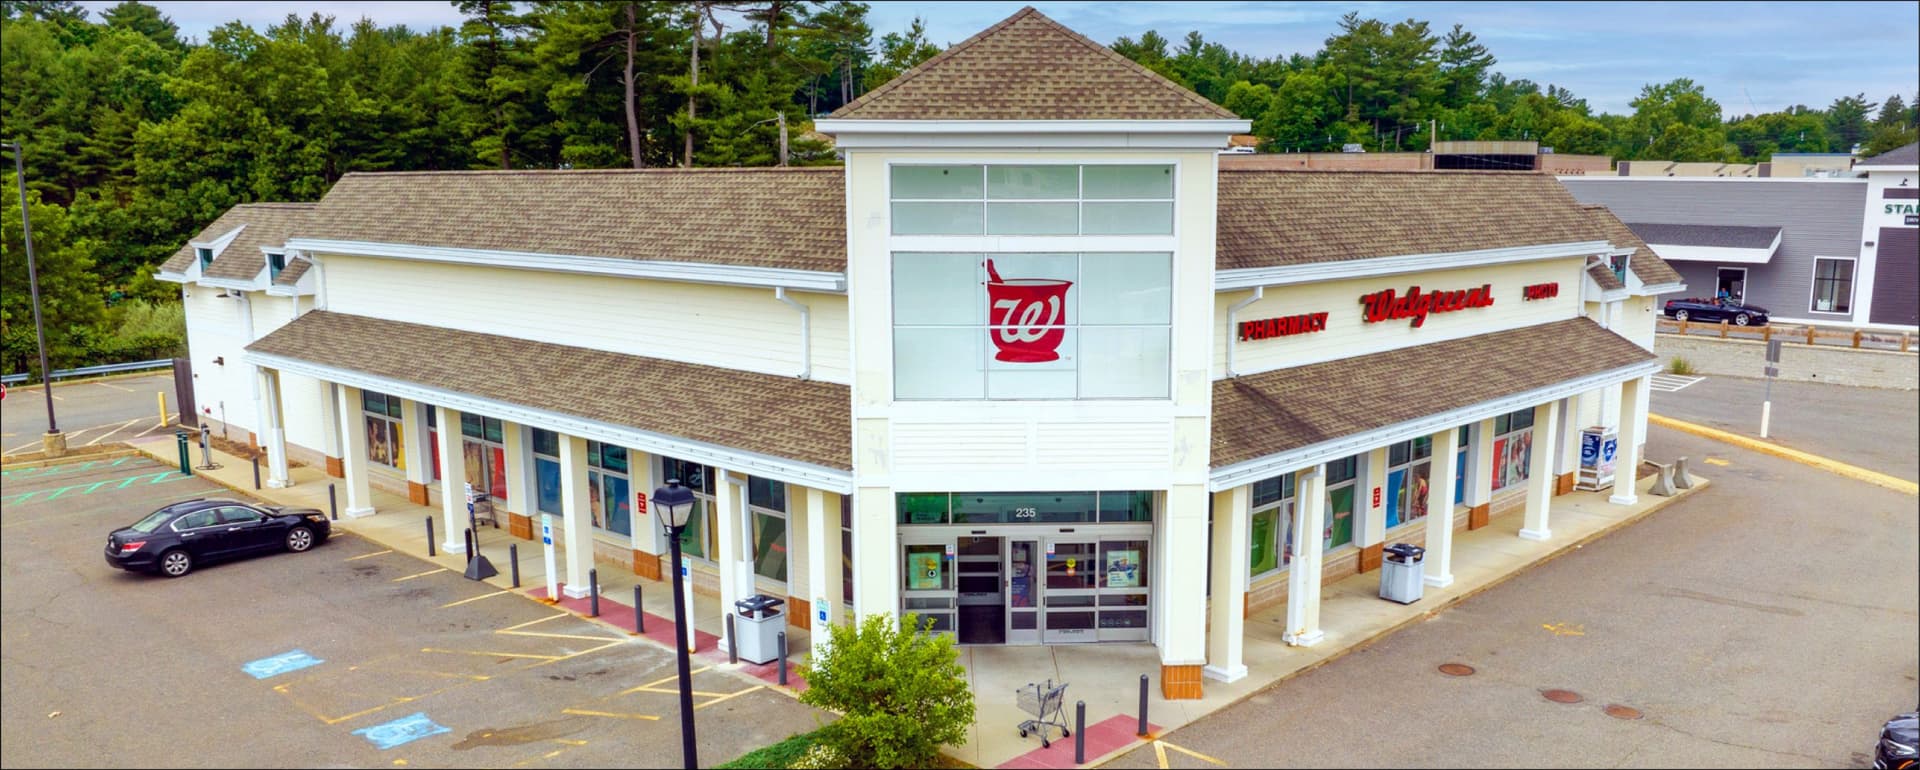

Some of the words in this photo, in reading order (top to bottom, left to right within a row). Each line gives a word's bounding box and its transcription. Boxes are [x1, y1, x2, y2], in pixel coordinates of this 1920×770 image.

[1526, 282, 1559, 300] PHOTO
[1361, 284, 1494, 328] Walgreens
[1241, 312, 1329, 341] PHARMACY
[1016, 508, 1036, 518] 235
